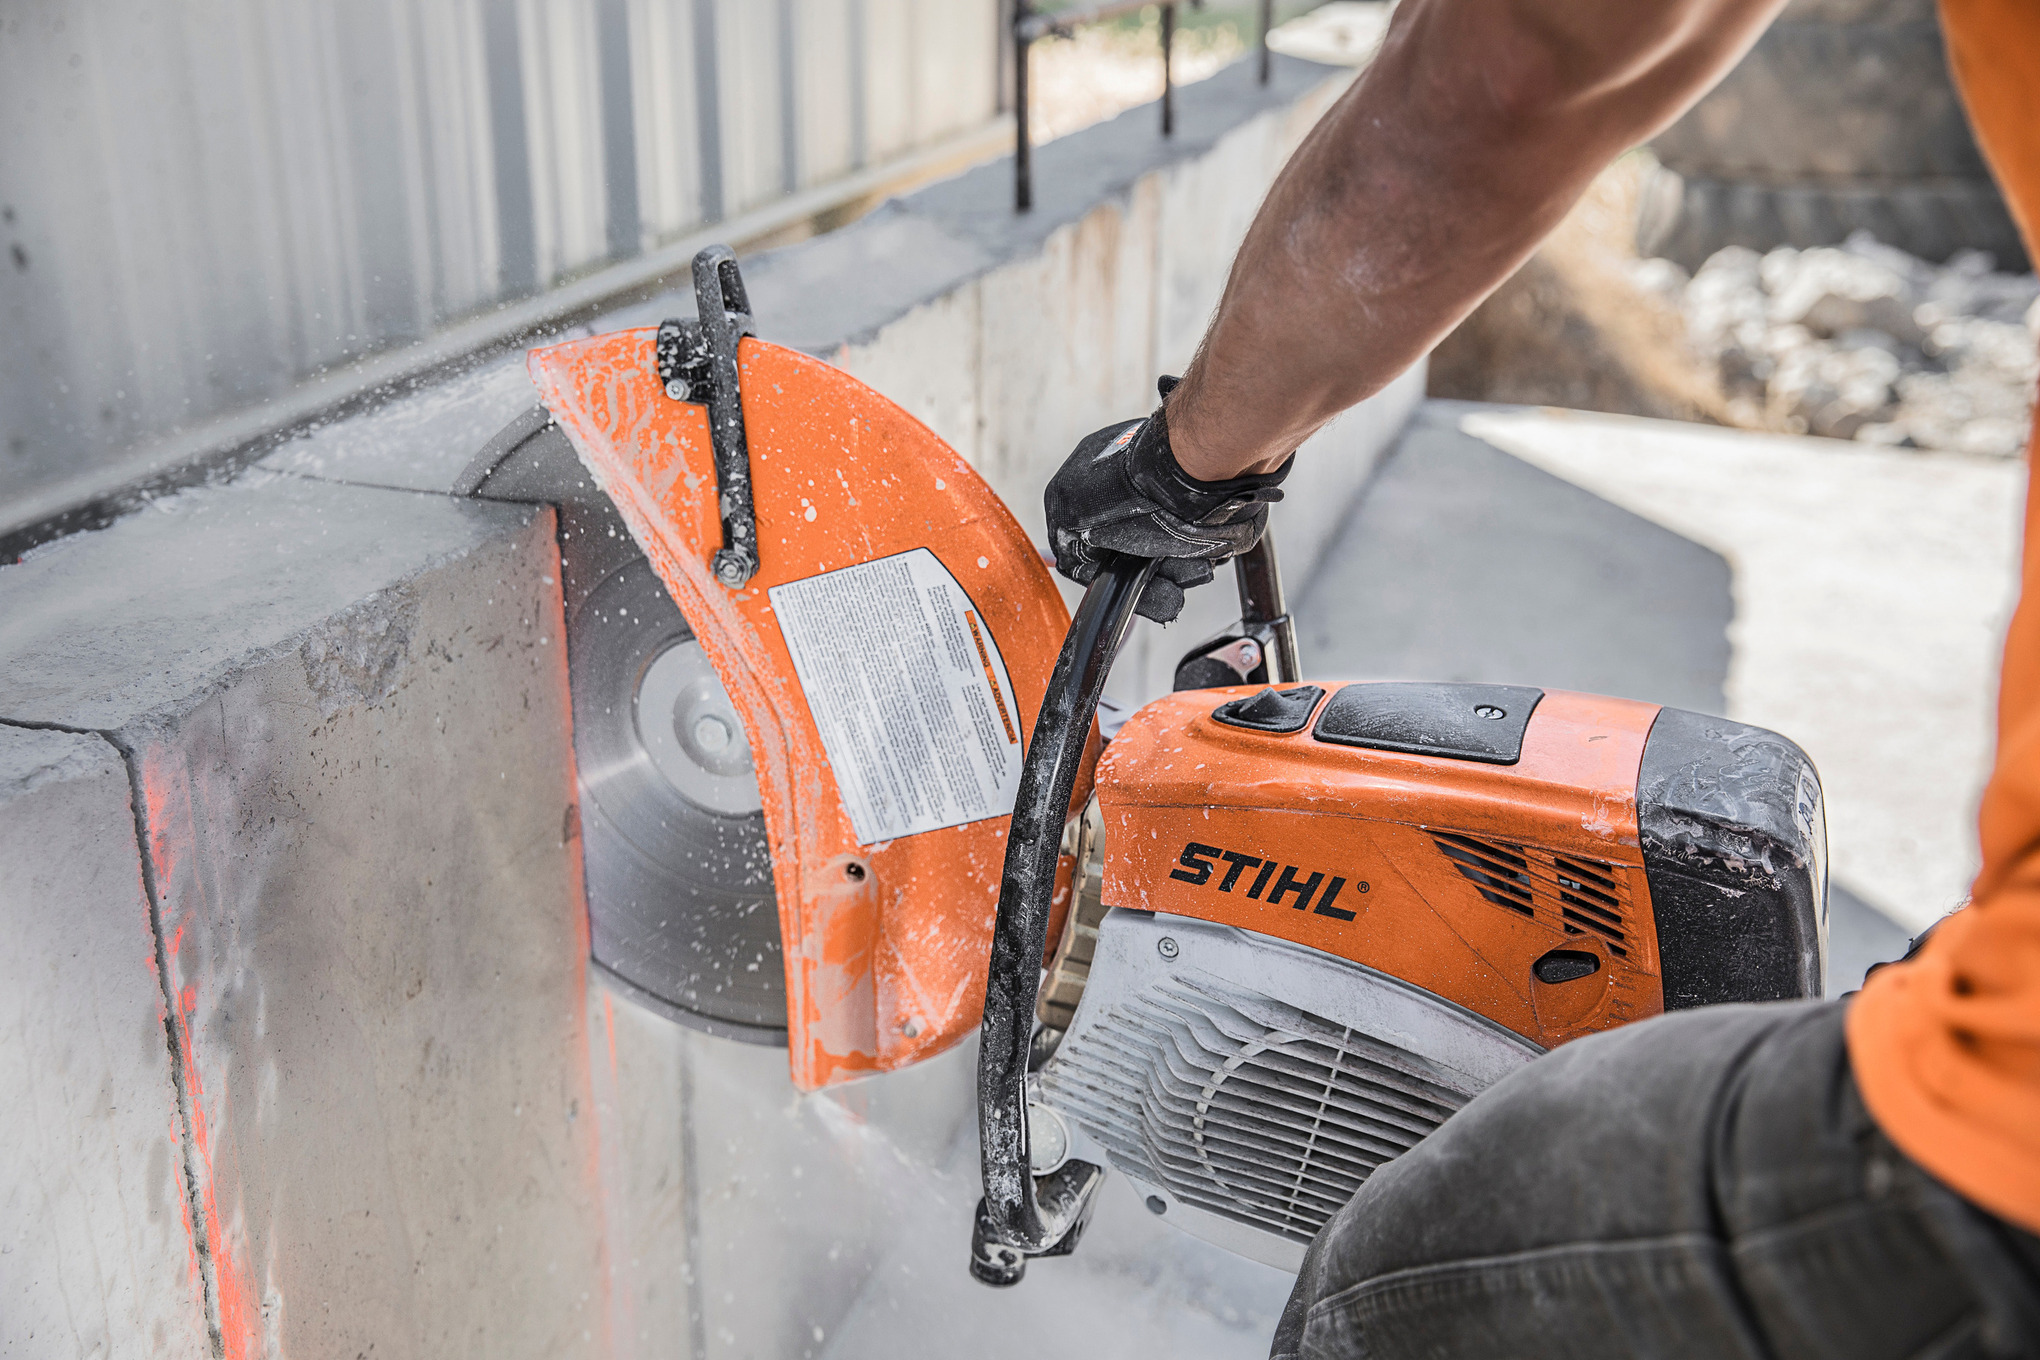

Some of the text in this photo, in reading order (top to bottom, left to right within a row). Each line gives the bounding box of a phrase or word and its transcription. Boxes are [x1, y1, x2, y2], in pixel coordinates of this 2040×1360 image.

[972, 628, 990, 668] WARNING
[992, 687, 1016, 742] ADVERTENCIA
[1169, 842, 1357, 922] STIHL
